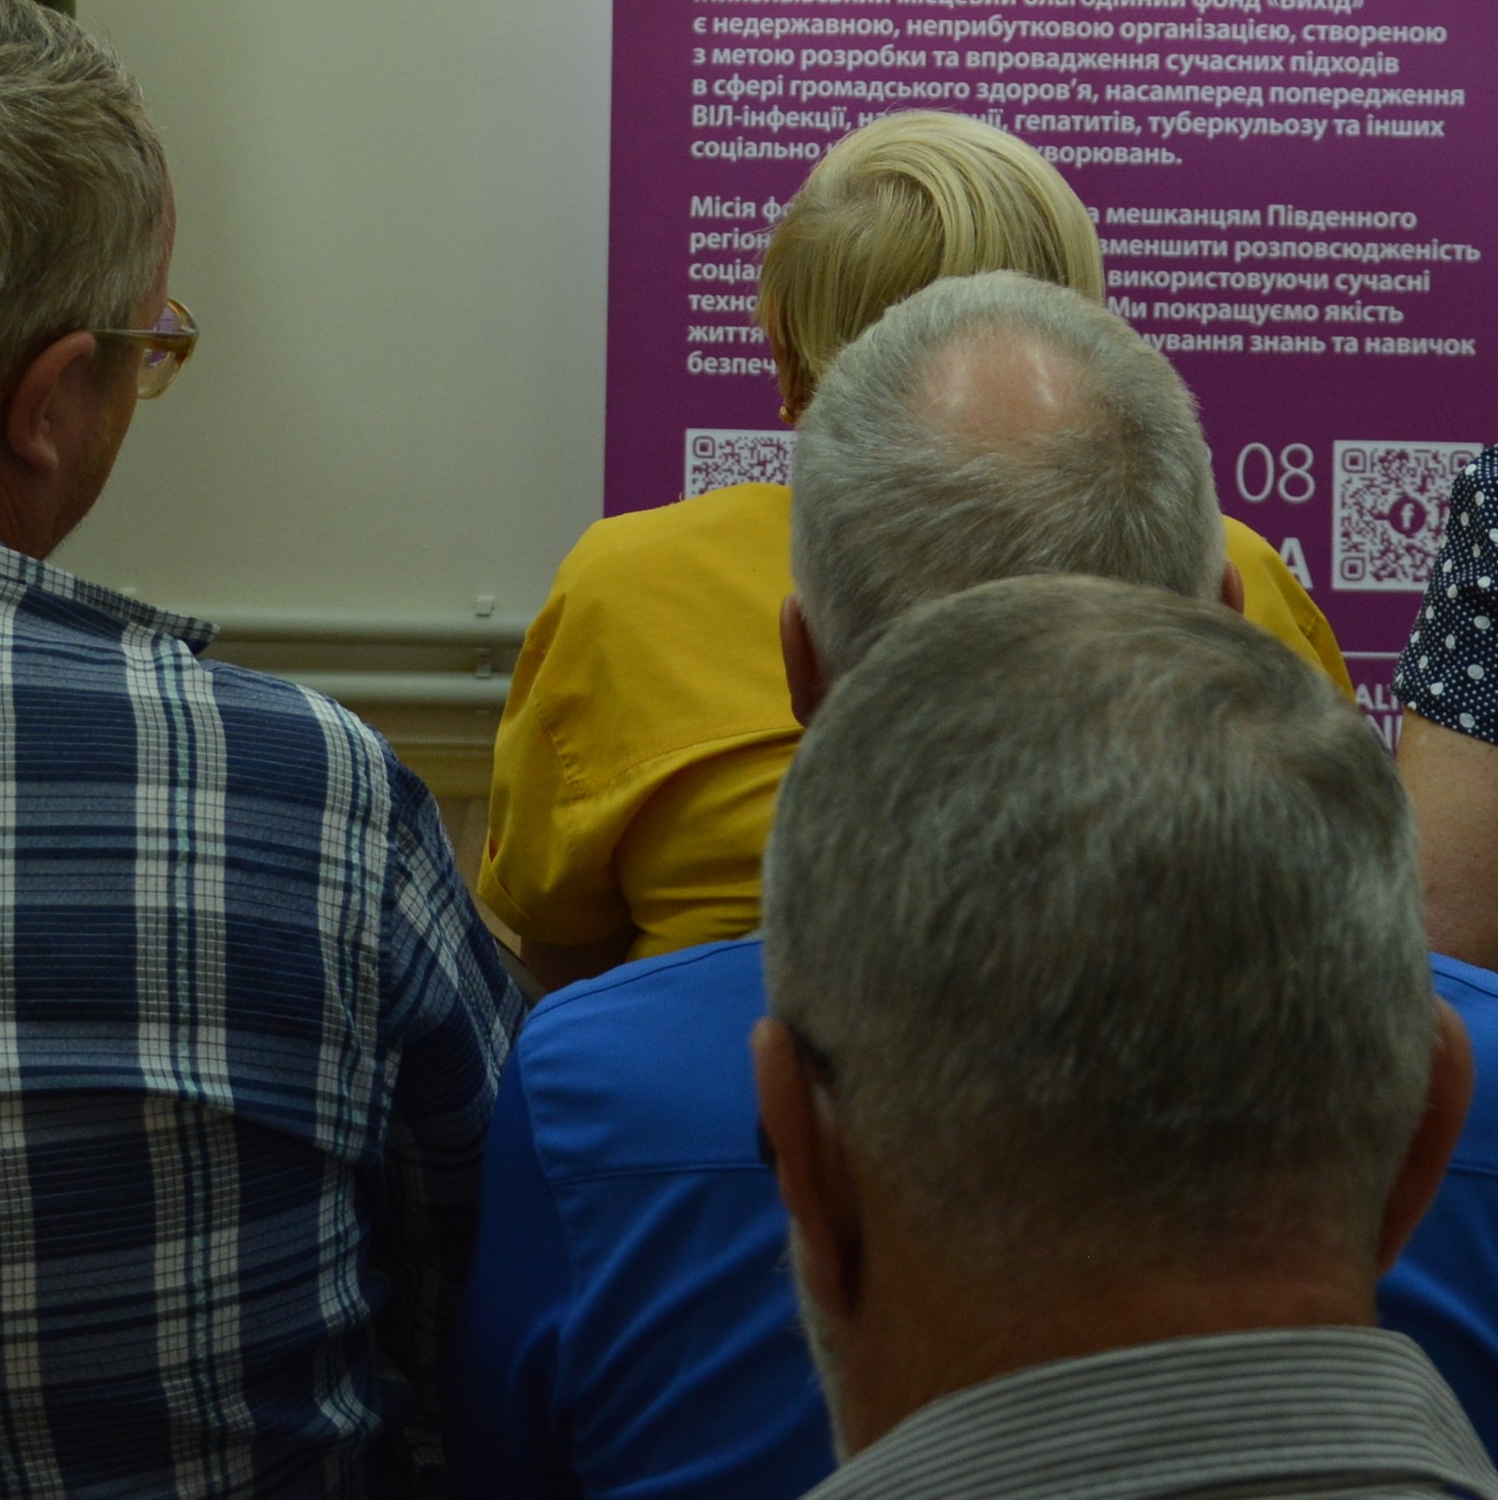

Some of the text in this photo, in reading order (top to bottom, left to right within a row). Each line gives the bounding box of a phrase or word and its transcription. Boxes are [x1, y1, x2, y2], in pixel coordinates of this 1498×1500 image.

[693, 14, 1447, 47] є недержавною, неприбутковою організацією, створеною
[693, 44, 1399, 77] з метою розробки та впровадження сучасних підходів
[693, 79, 707, 95] в
[713, 73, 783, 101] сфері
[790, 80, 970, 102] громадського
[1106, 84, 1263, 107] насамперед
[1269, 87, 1465, 109] попередження
[692, 105, 851, 132] ВІЛ-інфекції,
[1015, 110, 1141, 135] гепатитів,
[1148, 111, 1328, 141] туберкульозу
[1333, 119, 1360, 136] та
[1367, 114, 1444, 137] інших
[691, 136, 820, 161] соціально
[1036, 144, 1183, 168] ворювань.
[691, 196, 756, 219] Місія
[1106, 208, 1261, 229] мешканцям
[1268, 204, 1417, 231] Південного
[690, 228, 1481, 263] регіон зменшити розповсюдженість
[1108, 270, 1329, 294] використовуючи
[1335, 270, 1430, 296] сучасні
[1108, 297, 1147, 319] Ми
[1154, 302, 1319, 326] покращуємо
[1325, 300, 1404, 323] якість
[687, 326, 764, 343] життя
[1250, 335, 1326, 353] знань
[1331, 336, 1358, 354] та
[1365, 337, 1475, 355] навичок
